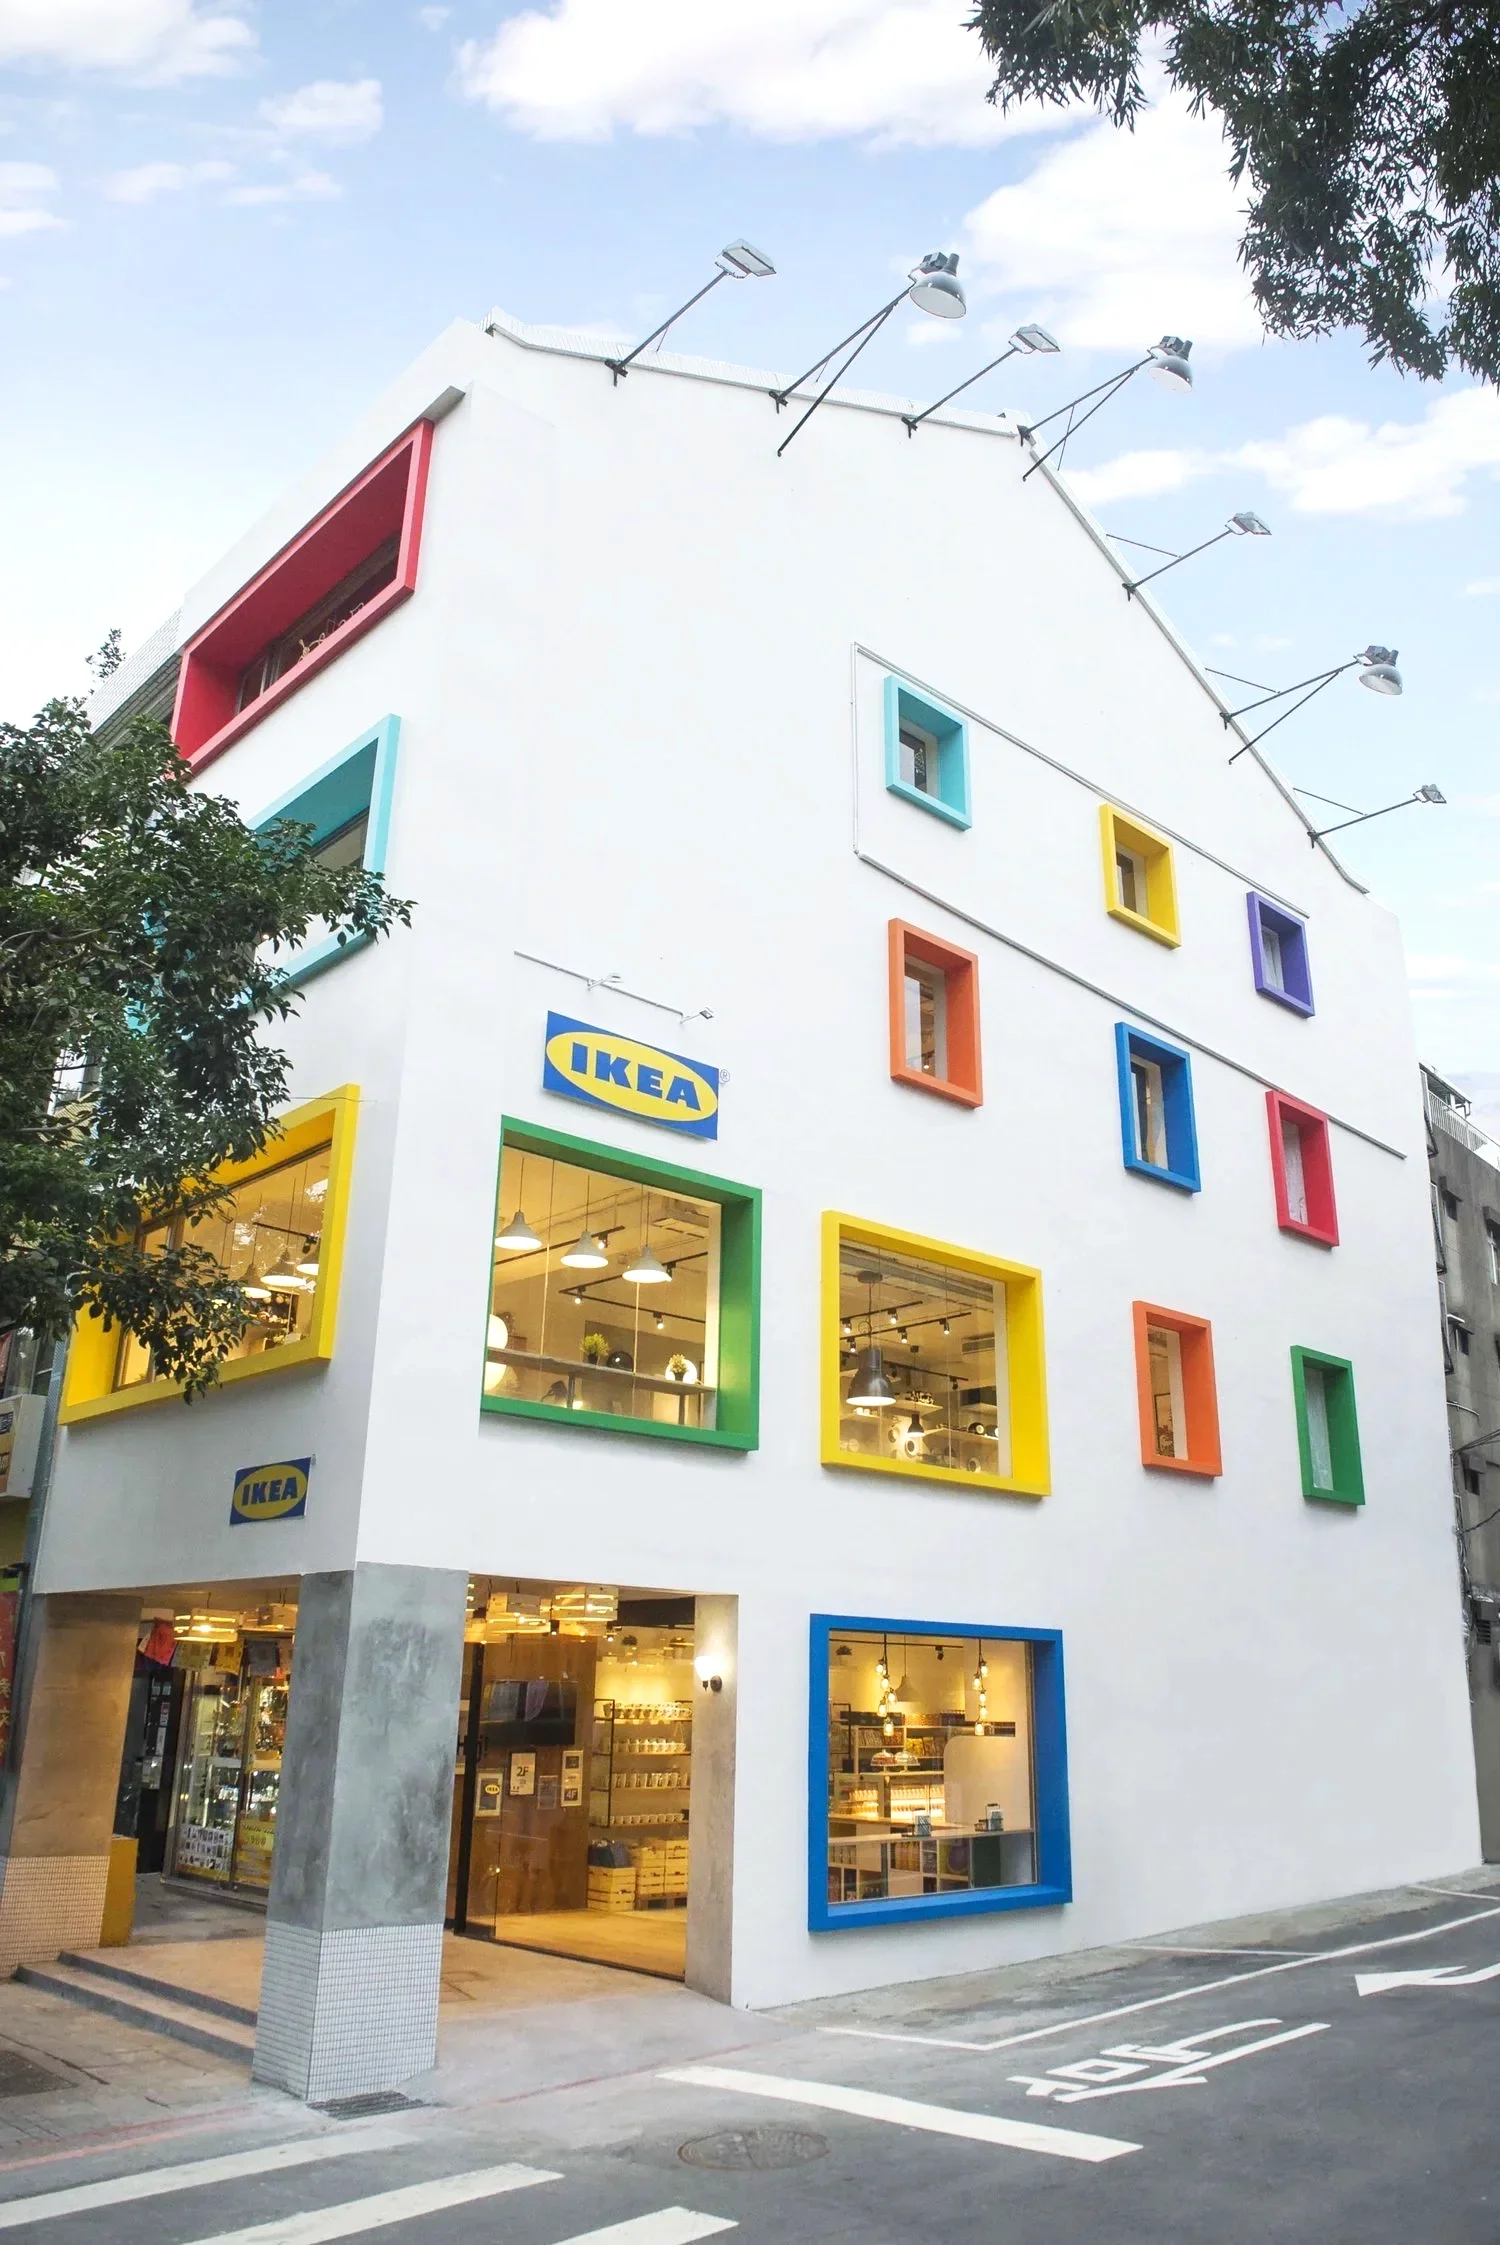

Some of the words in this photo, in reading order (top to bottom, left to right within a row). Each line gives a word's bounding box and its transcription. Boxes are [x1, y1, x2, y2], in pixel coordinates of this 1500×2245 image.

[571, 1042, 702, 1111] IKEA
[241, 1477, 299, 1506] IKEA
[516, 1766, 529, 1777] 2F
[1007, 2018, 1331, 2103] 停
